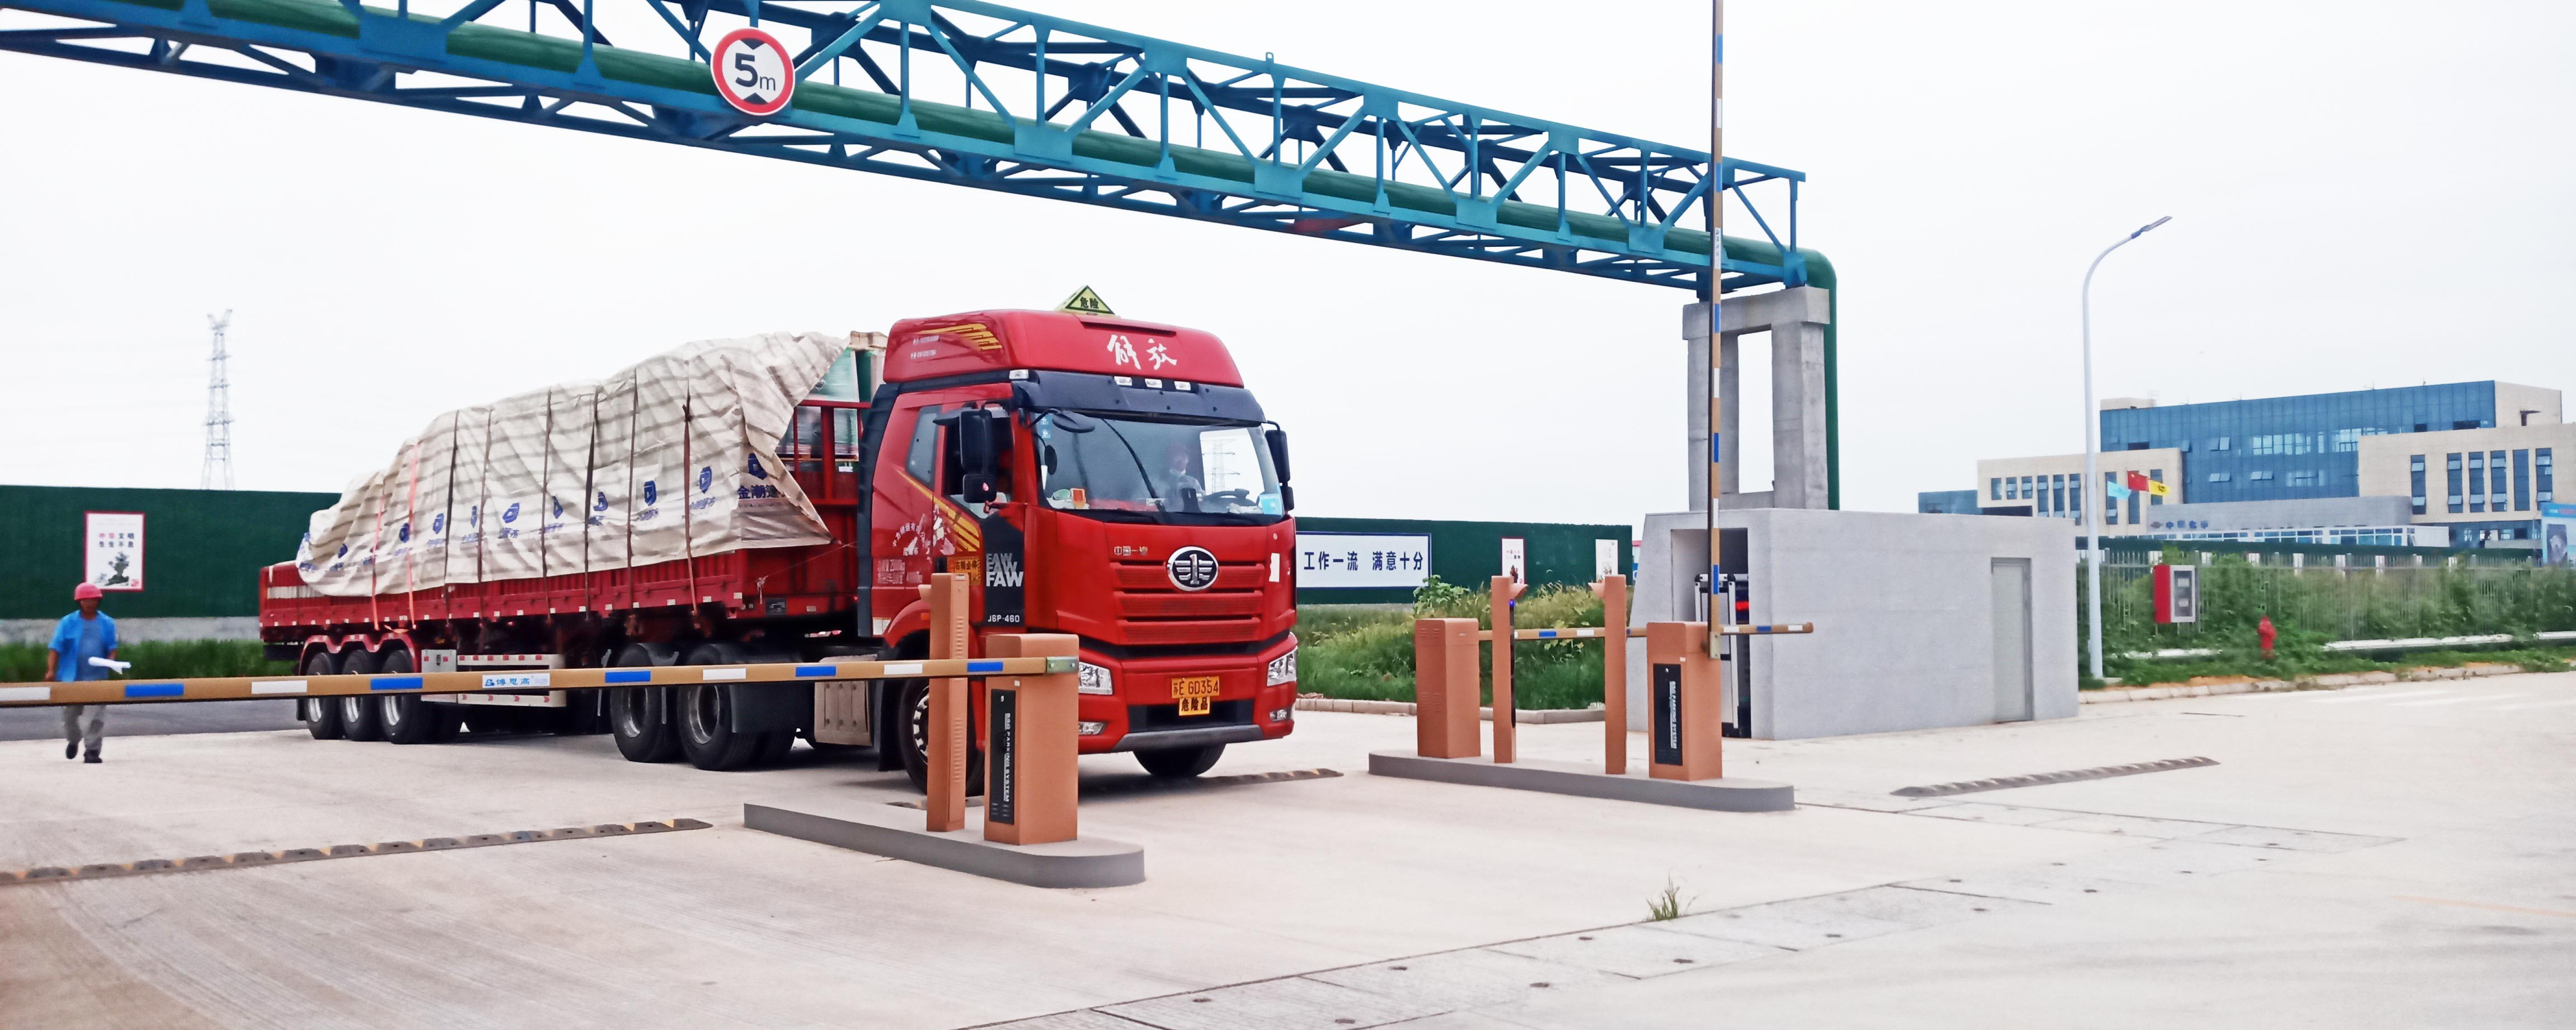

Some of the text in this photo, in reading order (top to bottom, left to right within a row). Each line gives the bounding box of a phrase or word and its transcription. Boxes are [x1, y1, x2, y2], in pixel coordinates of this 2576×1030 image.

[1080, 297, 1099, 309] 危险
[1107, 334, 1177, 370] 解放
[1304, 551, 1423, 570] 工作一流 满意十分
[986, 572, 1024, 587] FAW
[1181, 697, 1208, 711] 危险品
